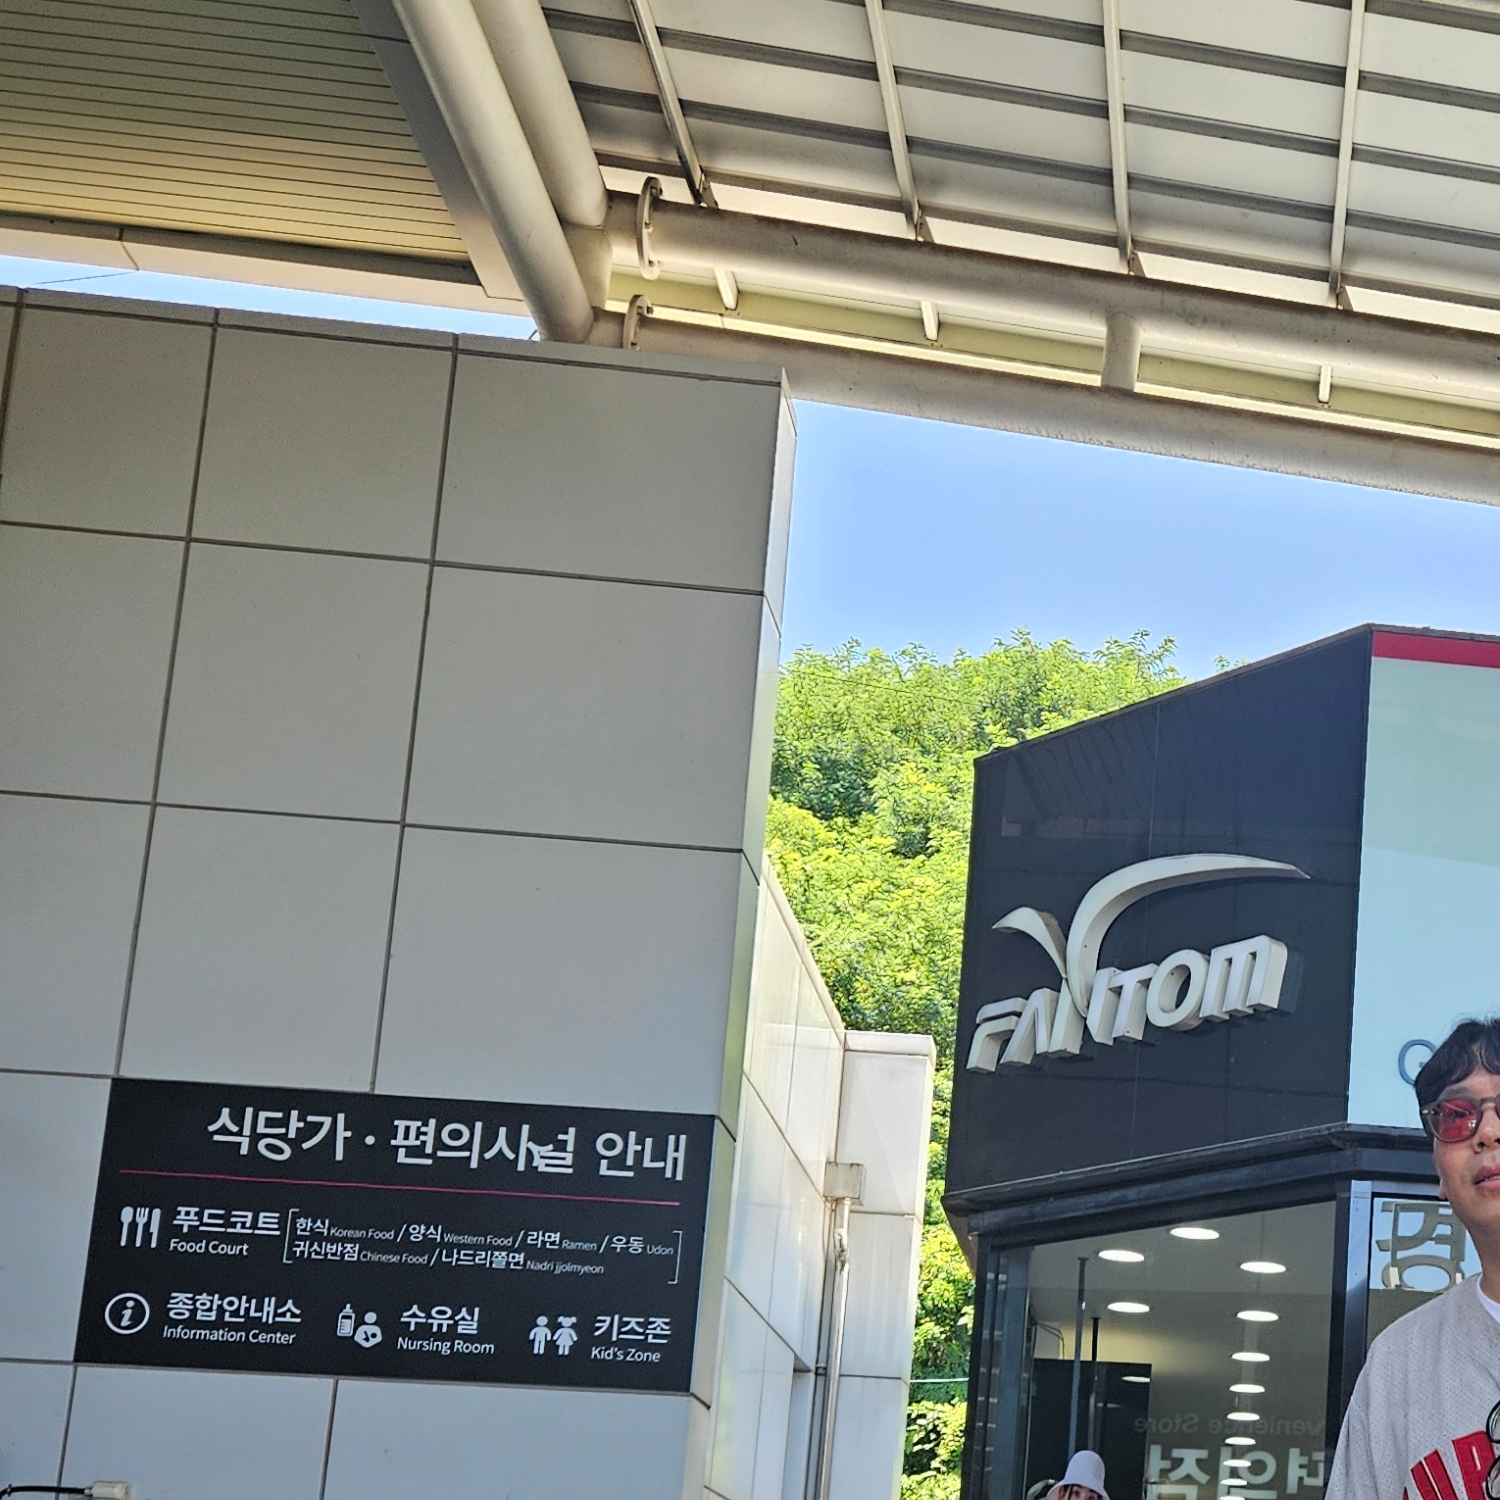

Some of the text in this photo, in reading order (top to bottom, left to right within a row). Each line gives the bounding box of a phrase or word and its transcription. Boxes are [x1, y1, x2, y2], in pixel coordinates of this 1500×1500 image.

[966, 920, 1290, 1071] FANTOM
[207, 1106, 352, 1161] 식당가
[596, 1130, 688, 1182] 안내
[172, 1206, 281, 1236] 푸드코트
[295, 1217, 330, 1238] 한식
[330, 1226, 366, 1239] Korean
[367, 1228, 395, 1241] Food
[408, 1223, 443, 1244] 양식
[443, 1233, 485, 1246] Western
[486, 1235, 513, 1247] Food
[527, 1231, 561, 1249] 라면
[561, 1239, 598, 1252] Ramen
[610, 1235, 645, 1255] 우동
[646, 1244, 674, 1256] Udon
[169, 1238, 249, 1256] Food Court
[292, 1240, 360, 1262] 귀신반점
[360, 1250, 401, 1264] Chinese
[401, 1253, 429, 1265] Food
[441, 1248, 526, 1270] 나드리쫄면
[526, 1259, 554, 1272] Nadri
[553, 1260, 605, 1276] jjolmyeon
[166, 1292, 302, 1325] 종합안내소
[400, 1304, 481, 1335] 수유실
[162, 1325, 297, 1345] Information Center
[593, 1313, 673, 1344] 키즈존
[396, 1336, 496, 1356] Nursing Room
[590, 1345, 661, 1363] Kid's Zone
